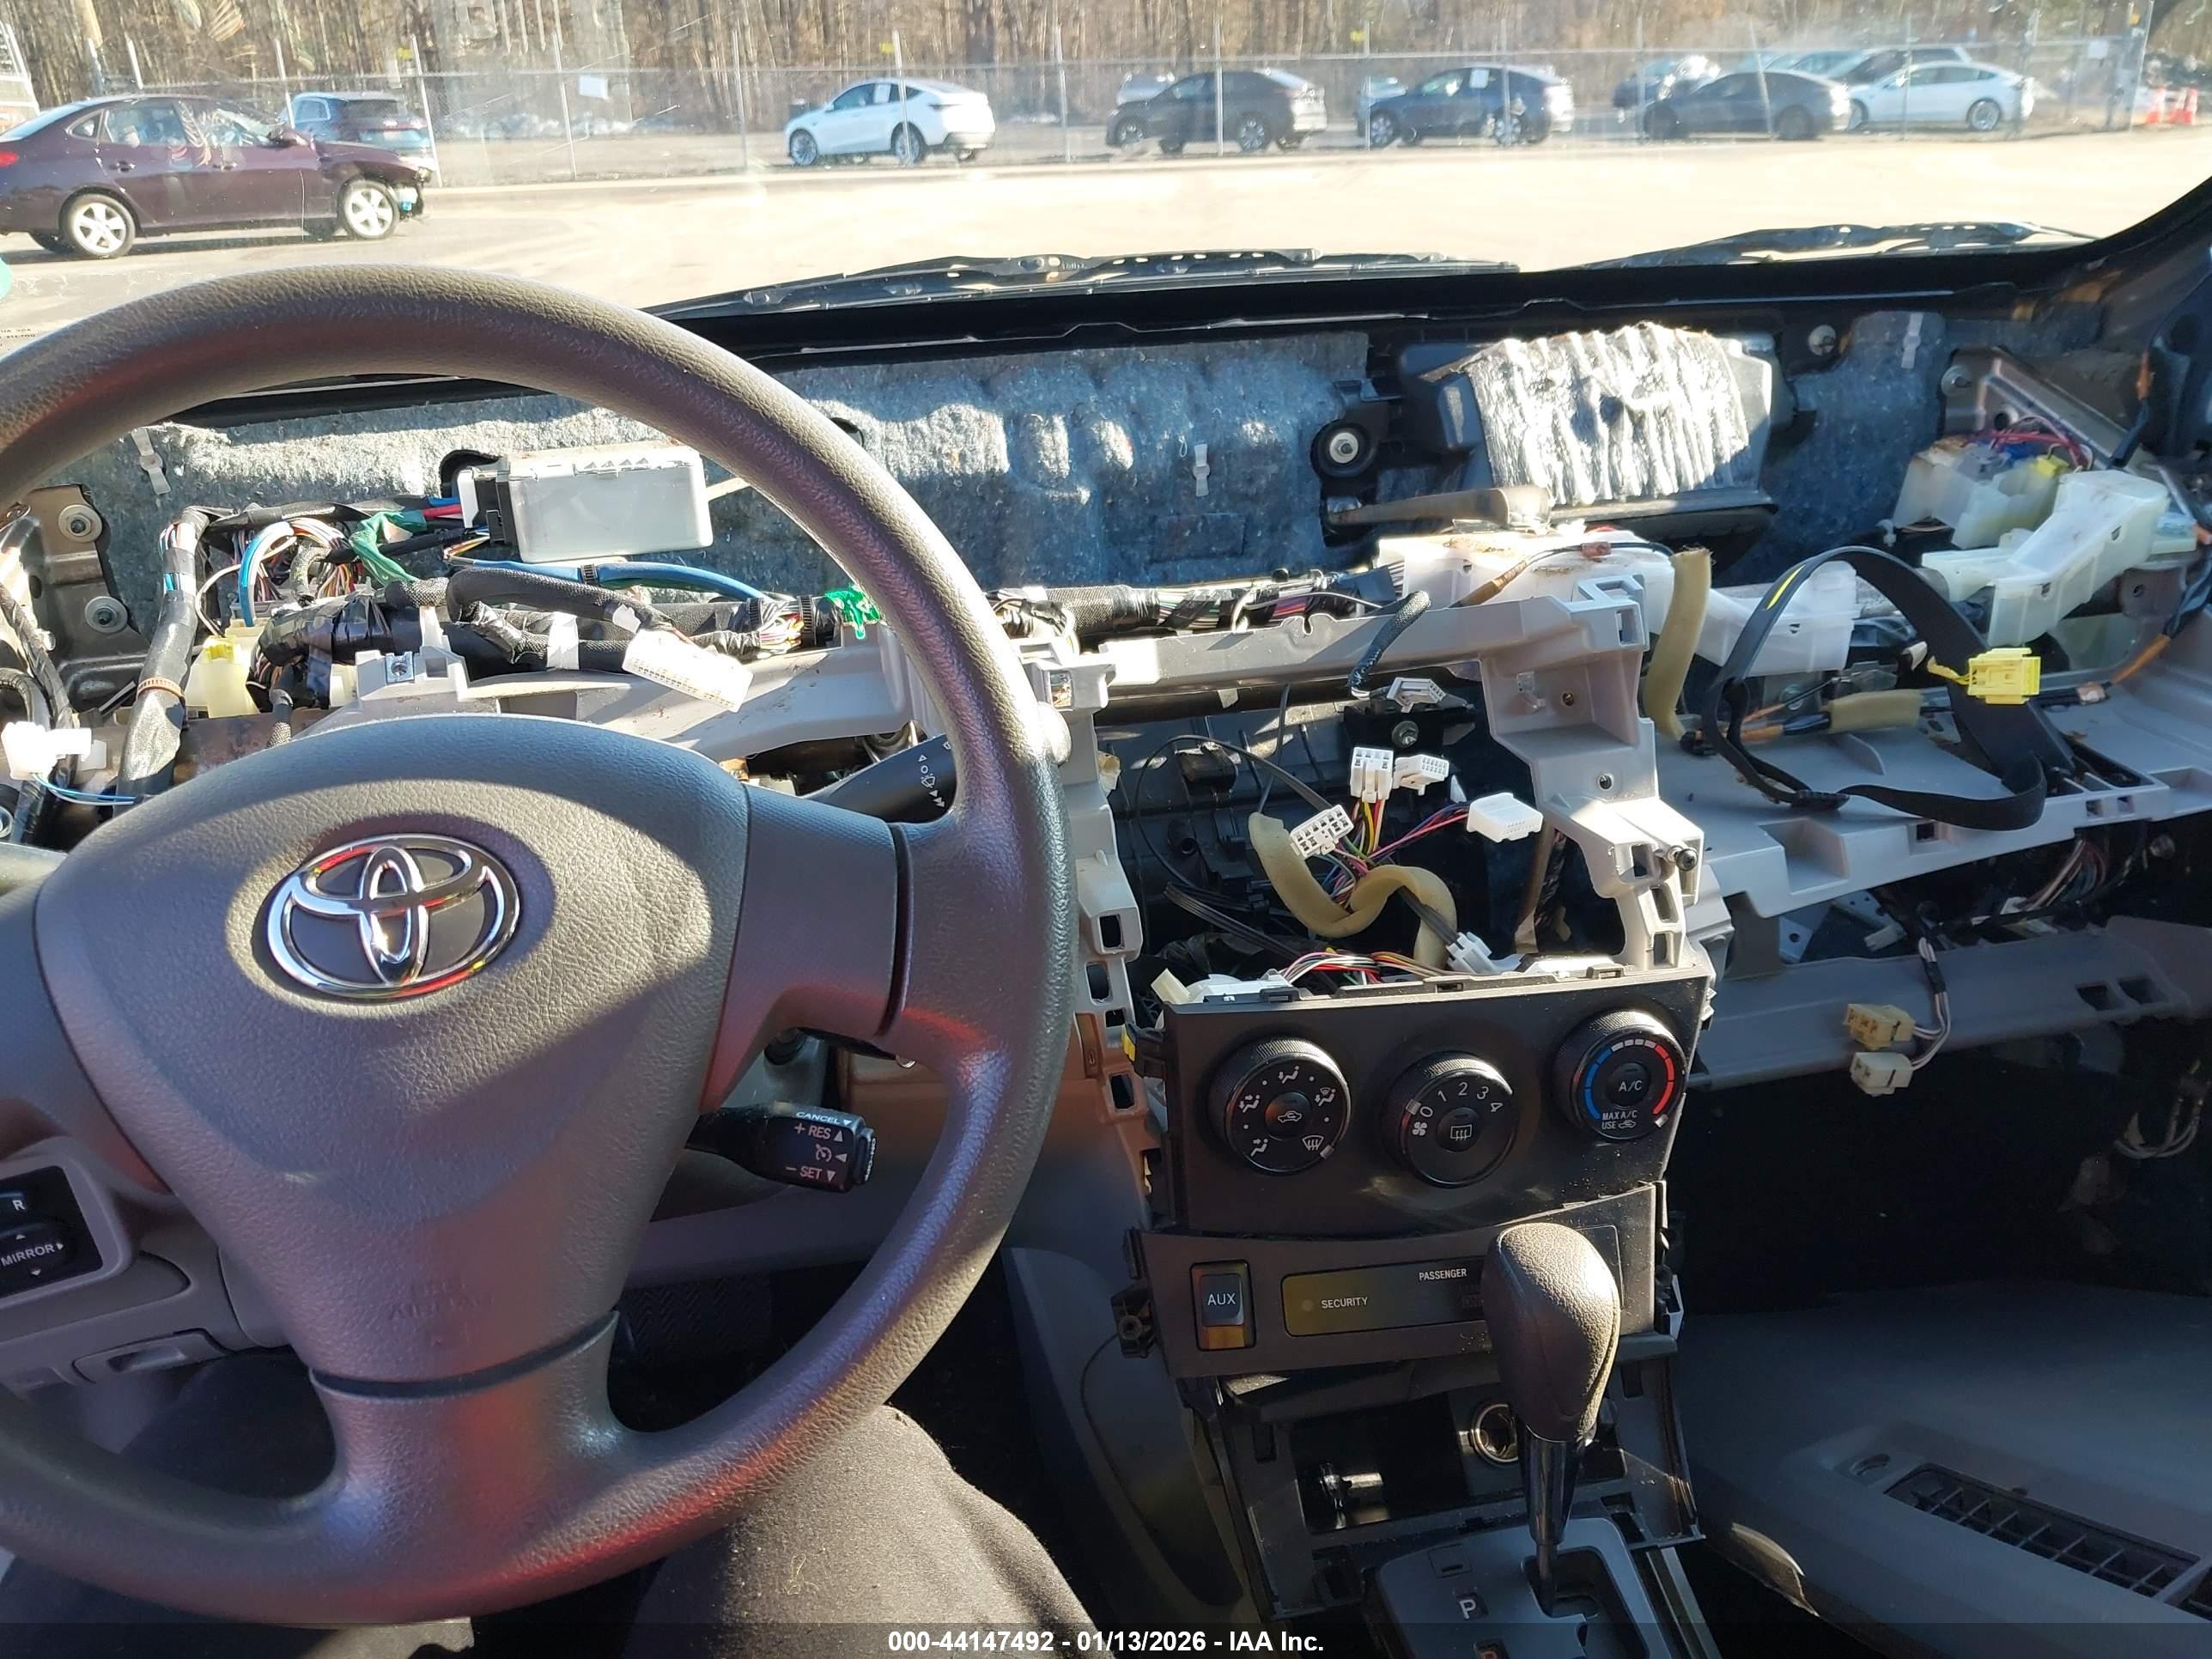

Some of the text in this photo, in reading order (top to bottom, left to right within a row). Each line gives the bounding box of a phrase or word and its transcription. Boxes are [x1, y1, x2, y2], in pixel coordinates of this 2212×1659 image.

[1458, 1082, 1468, 1096] 2
[1477, 1086, 1490, 1099] 3
[1619, 1080, 1642, 1092] A/C
[1437, 1090, 1447, 1102] 1
[1491, 1103, 1504, 1112] 4
[796, 1111, 841, 1125] CANCEL
[1602, 1110, 1638, 1120] MAX A/C
[1601, 1121, 1616, 1129] USE
[808, 1125, 831, 1139] RES
[799, 1165, 823, 1180] SET
[12, 1200, 25, 1211] R
[0, 1243, 55, 1266] MIRROR
[1419, 1268, 1467, 1281] PASSENGER
[1207, 1292, 1237, 1306] AUX
[1321, 1297, 1368, 1310] SECURITY
[1459, 1599, 1476, 1620] P
